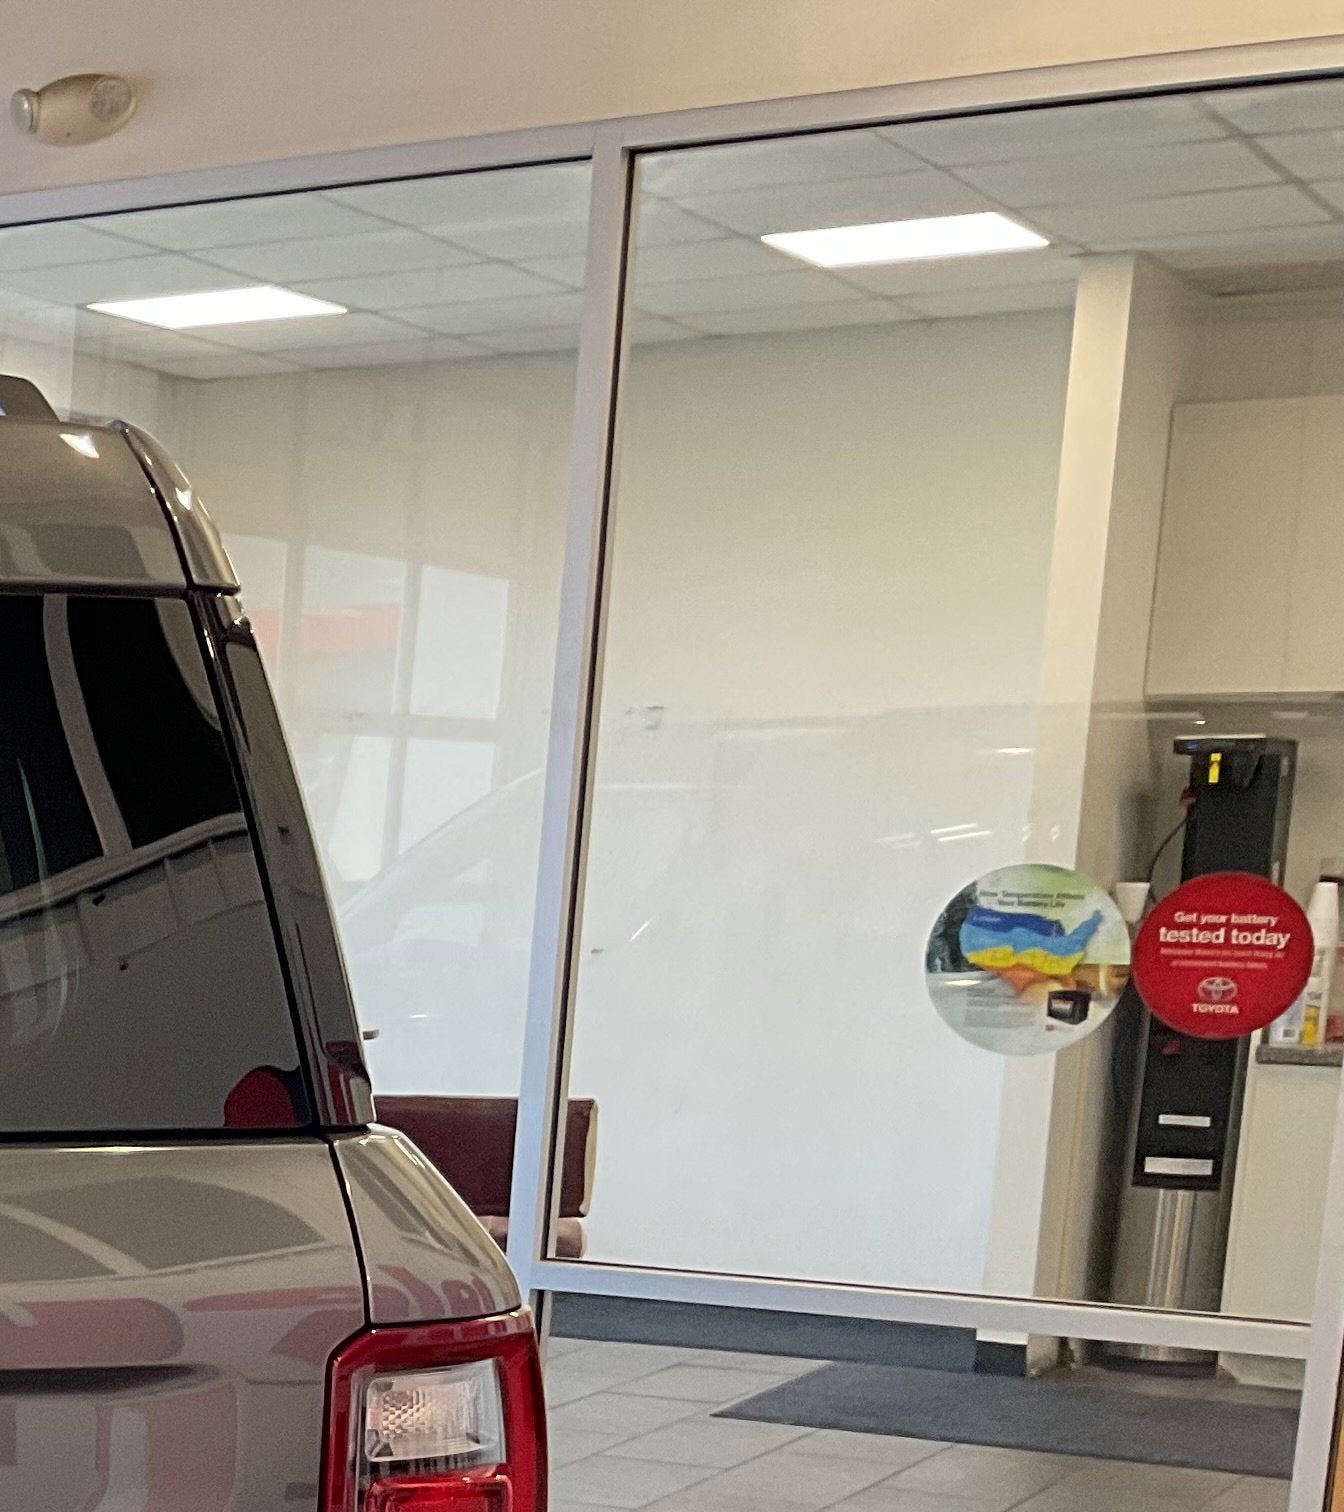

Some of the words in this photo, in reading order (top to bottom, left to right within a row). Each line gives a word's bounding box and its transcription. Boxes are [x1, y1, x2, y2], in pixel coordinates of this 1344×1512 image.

[1174, 911, 1197, 924] Get
[1200, 914, 1227, 926] your
[1231, 913, 1280, 927] battery
[1159, 926, 1225, 944] tested
[1231, 929, 1291, 949] today
[1191, 1003, 1240, 1014] TOYOTA
